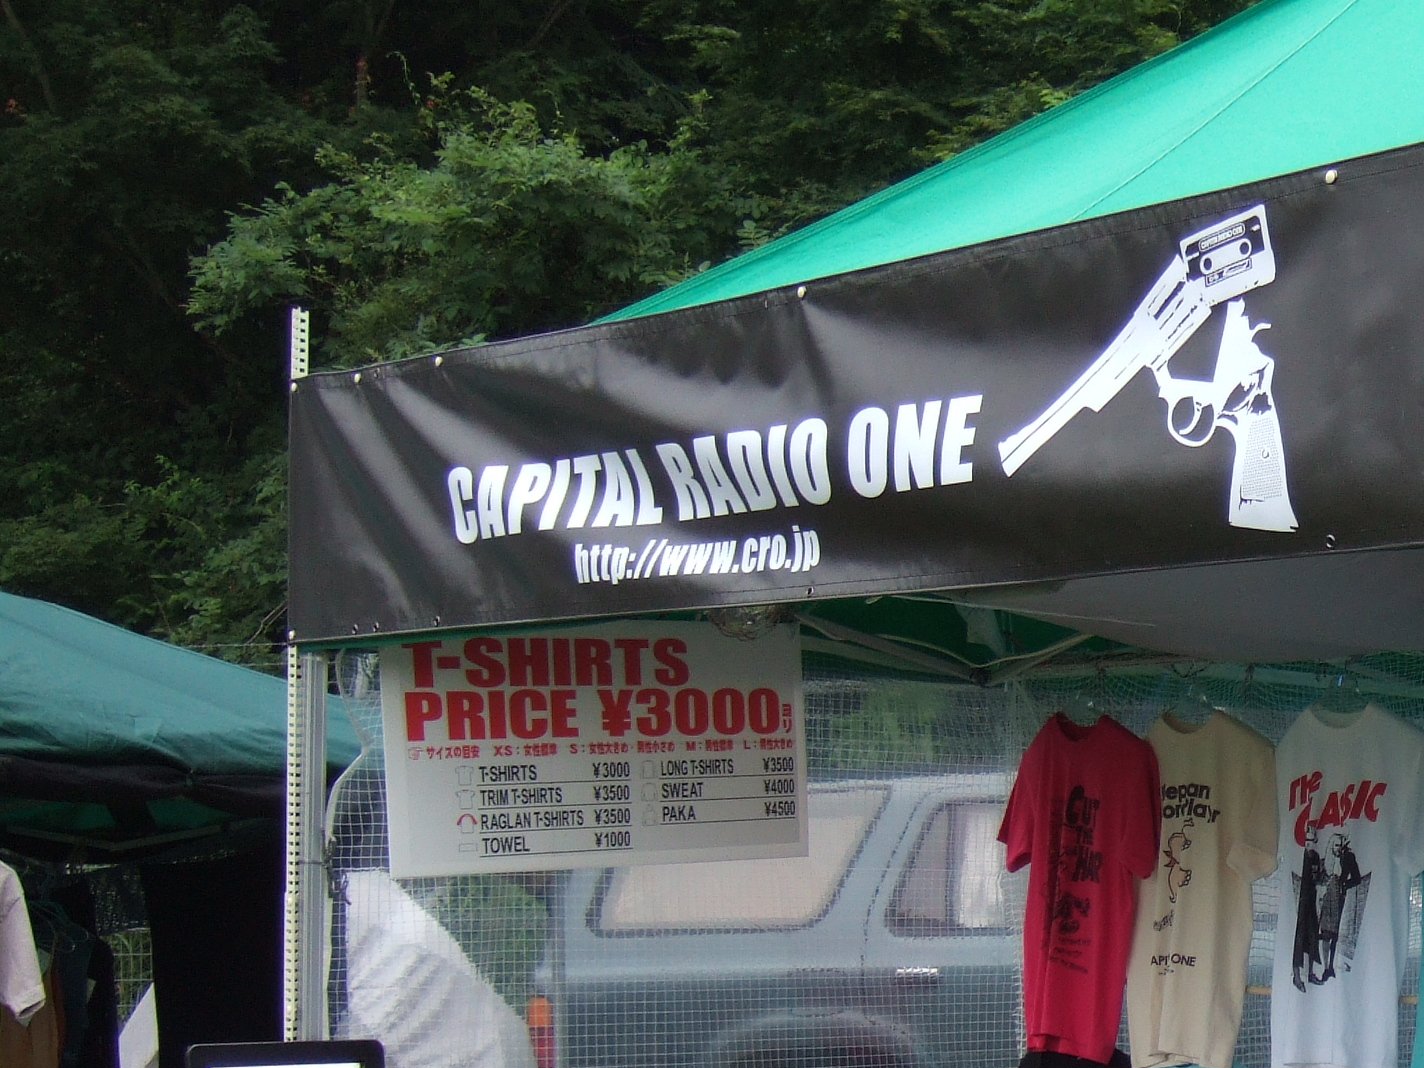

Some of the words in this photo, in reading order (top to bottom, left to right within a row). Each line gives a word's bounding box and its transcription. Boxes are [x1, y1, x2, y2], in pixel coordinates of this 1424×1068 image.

[446, 451, 663, 544] CAPITAL
[655, 417, 832, 522] RADIO
[847, 394, 983, 498] ONE
[573, 526, 821, 584] http://www.cro.jp
[402, 638, 690, 688] T-SHIRTS
[405, 689, 579, 741] PRICE
[596, 687, 780, 739] ¥3000
[478, 765, 537, 782] T-SHIRTS
[592, 761, 631, 778] ¥3000
[661, 759, 687, 776] LONG
[691, 758, 734, 775] T-SHIRTS
[763, 756, 794, 772] ¥3500
[480, 789, 509, 806] TRIM
[511, 787, 563, 804] T-SHIRTS
[593, 785, 631, 801] ¥3500
[661, 782, 704, 799] SWEAT
[764, 779, 795, 795] ¥4000
[481, 812, 531, 831] RAGLAN
[534, 809, 584, 828] T-SHIRTS
[594, 808, 631, 825] ¥3500
[662, 805, 696, 822] PAKA
[764, 801, 796, 817] ¥4500
[482, 836, 530, 854] TOWEL
[594, 831, 631, 848] ¥1000
